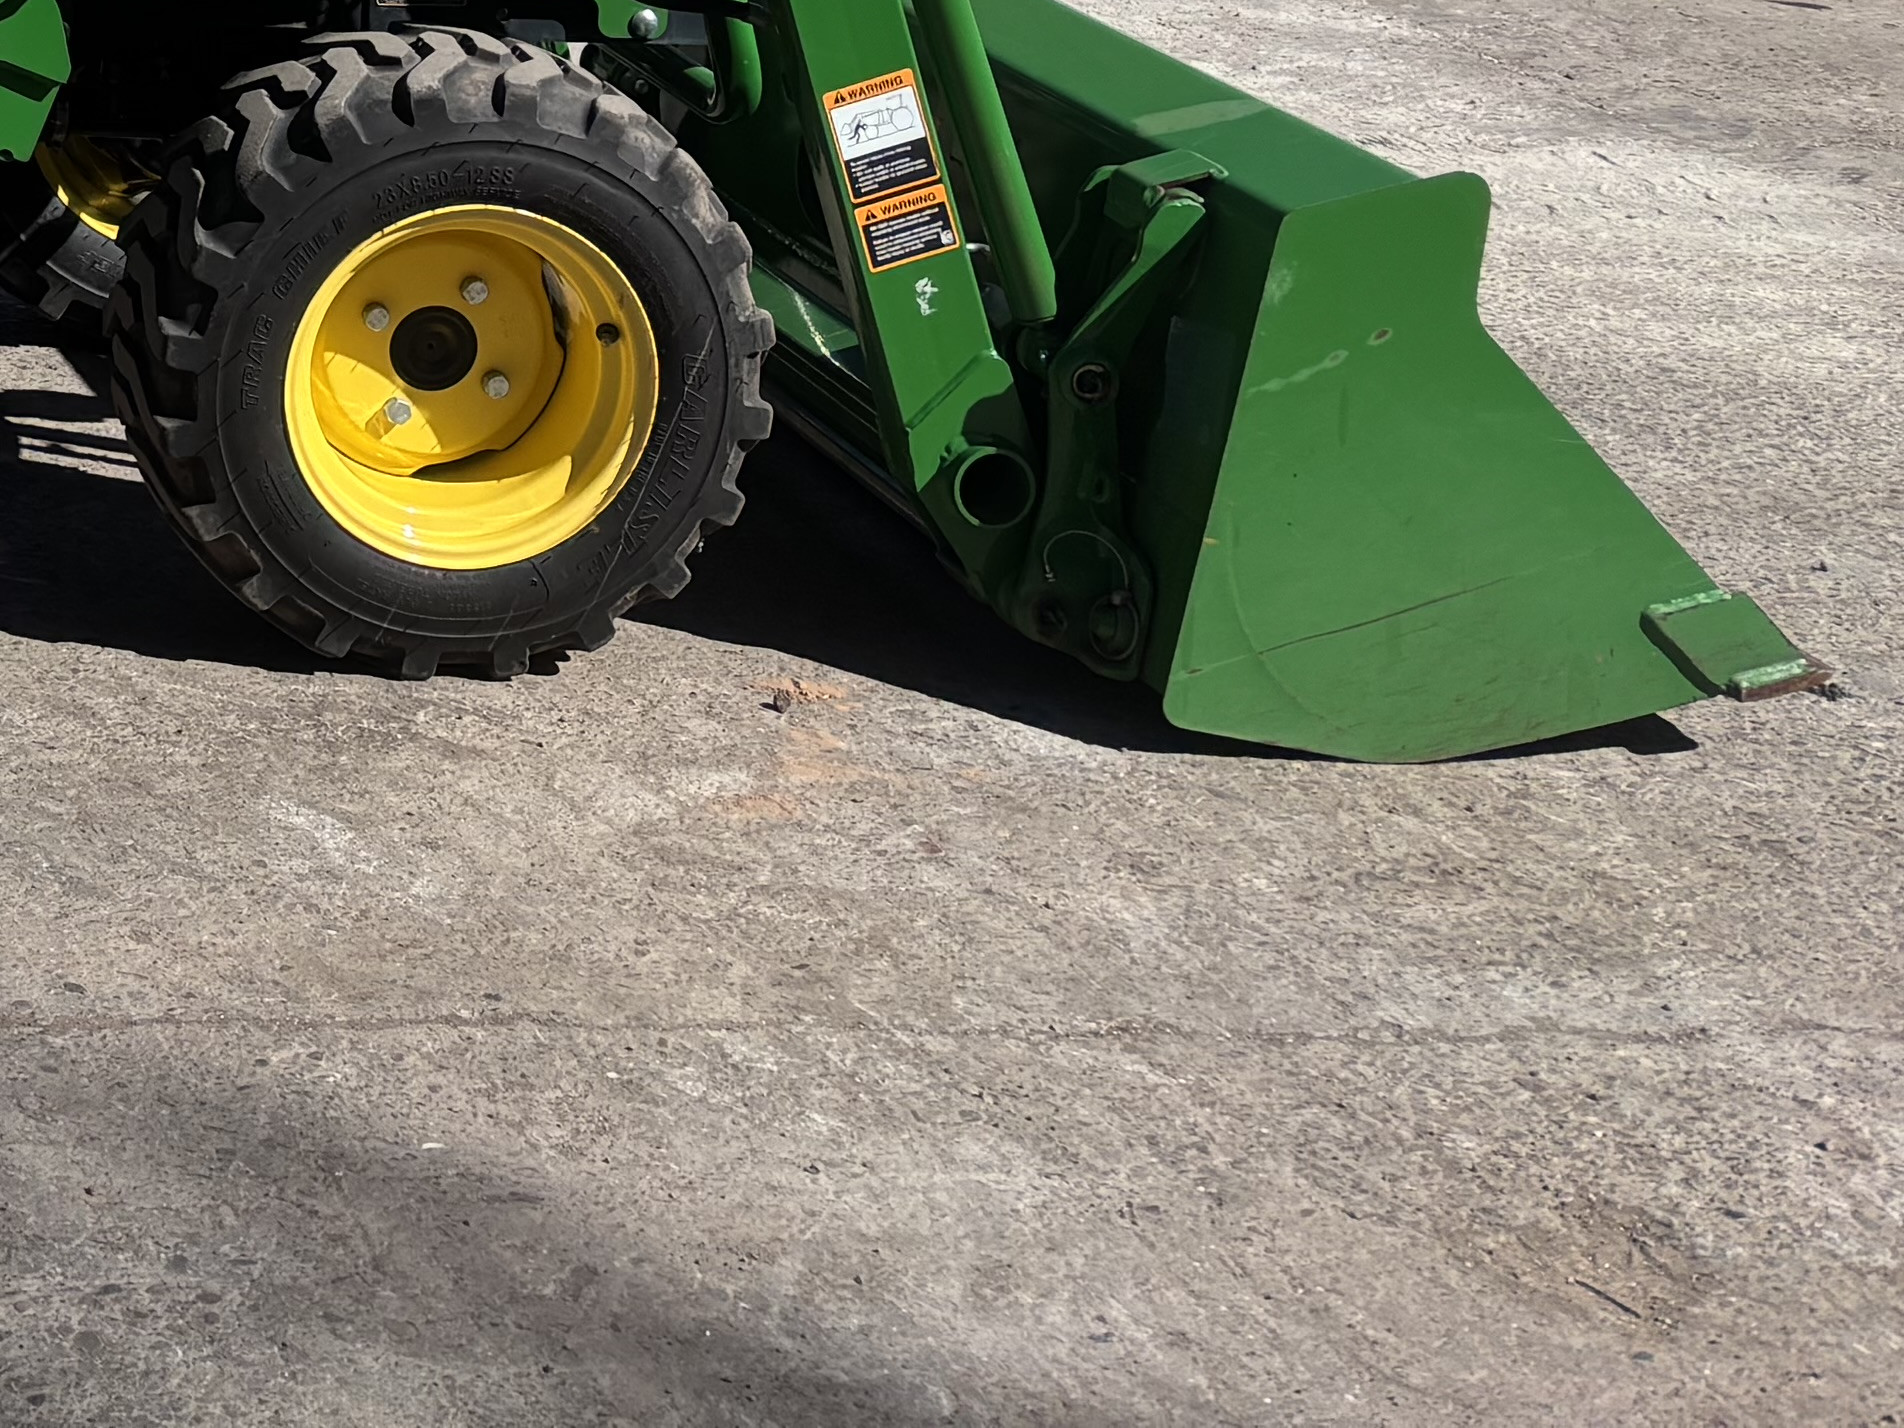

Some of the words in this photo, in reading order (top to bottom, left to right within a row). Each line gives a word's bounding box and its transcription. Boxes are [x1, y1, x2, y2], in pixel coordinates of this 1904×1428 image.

[848, 75, 904, 101] WARNING
[880, 192, 937, 216] WARNING
[241, 313, 274, 410] TRAC
